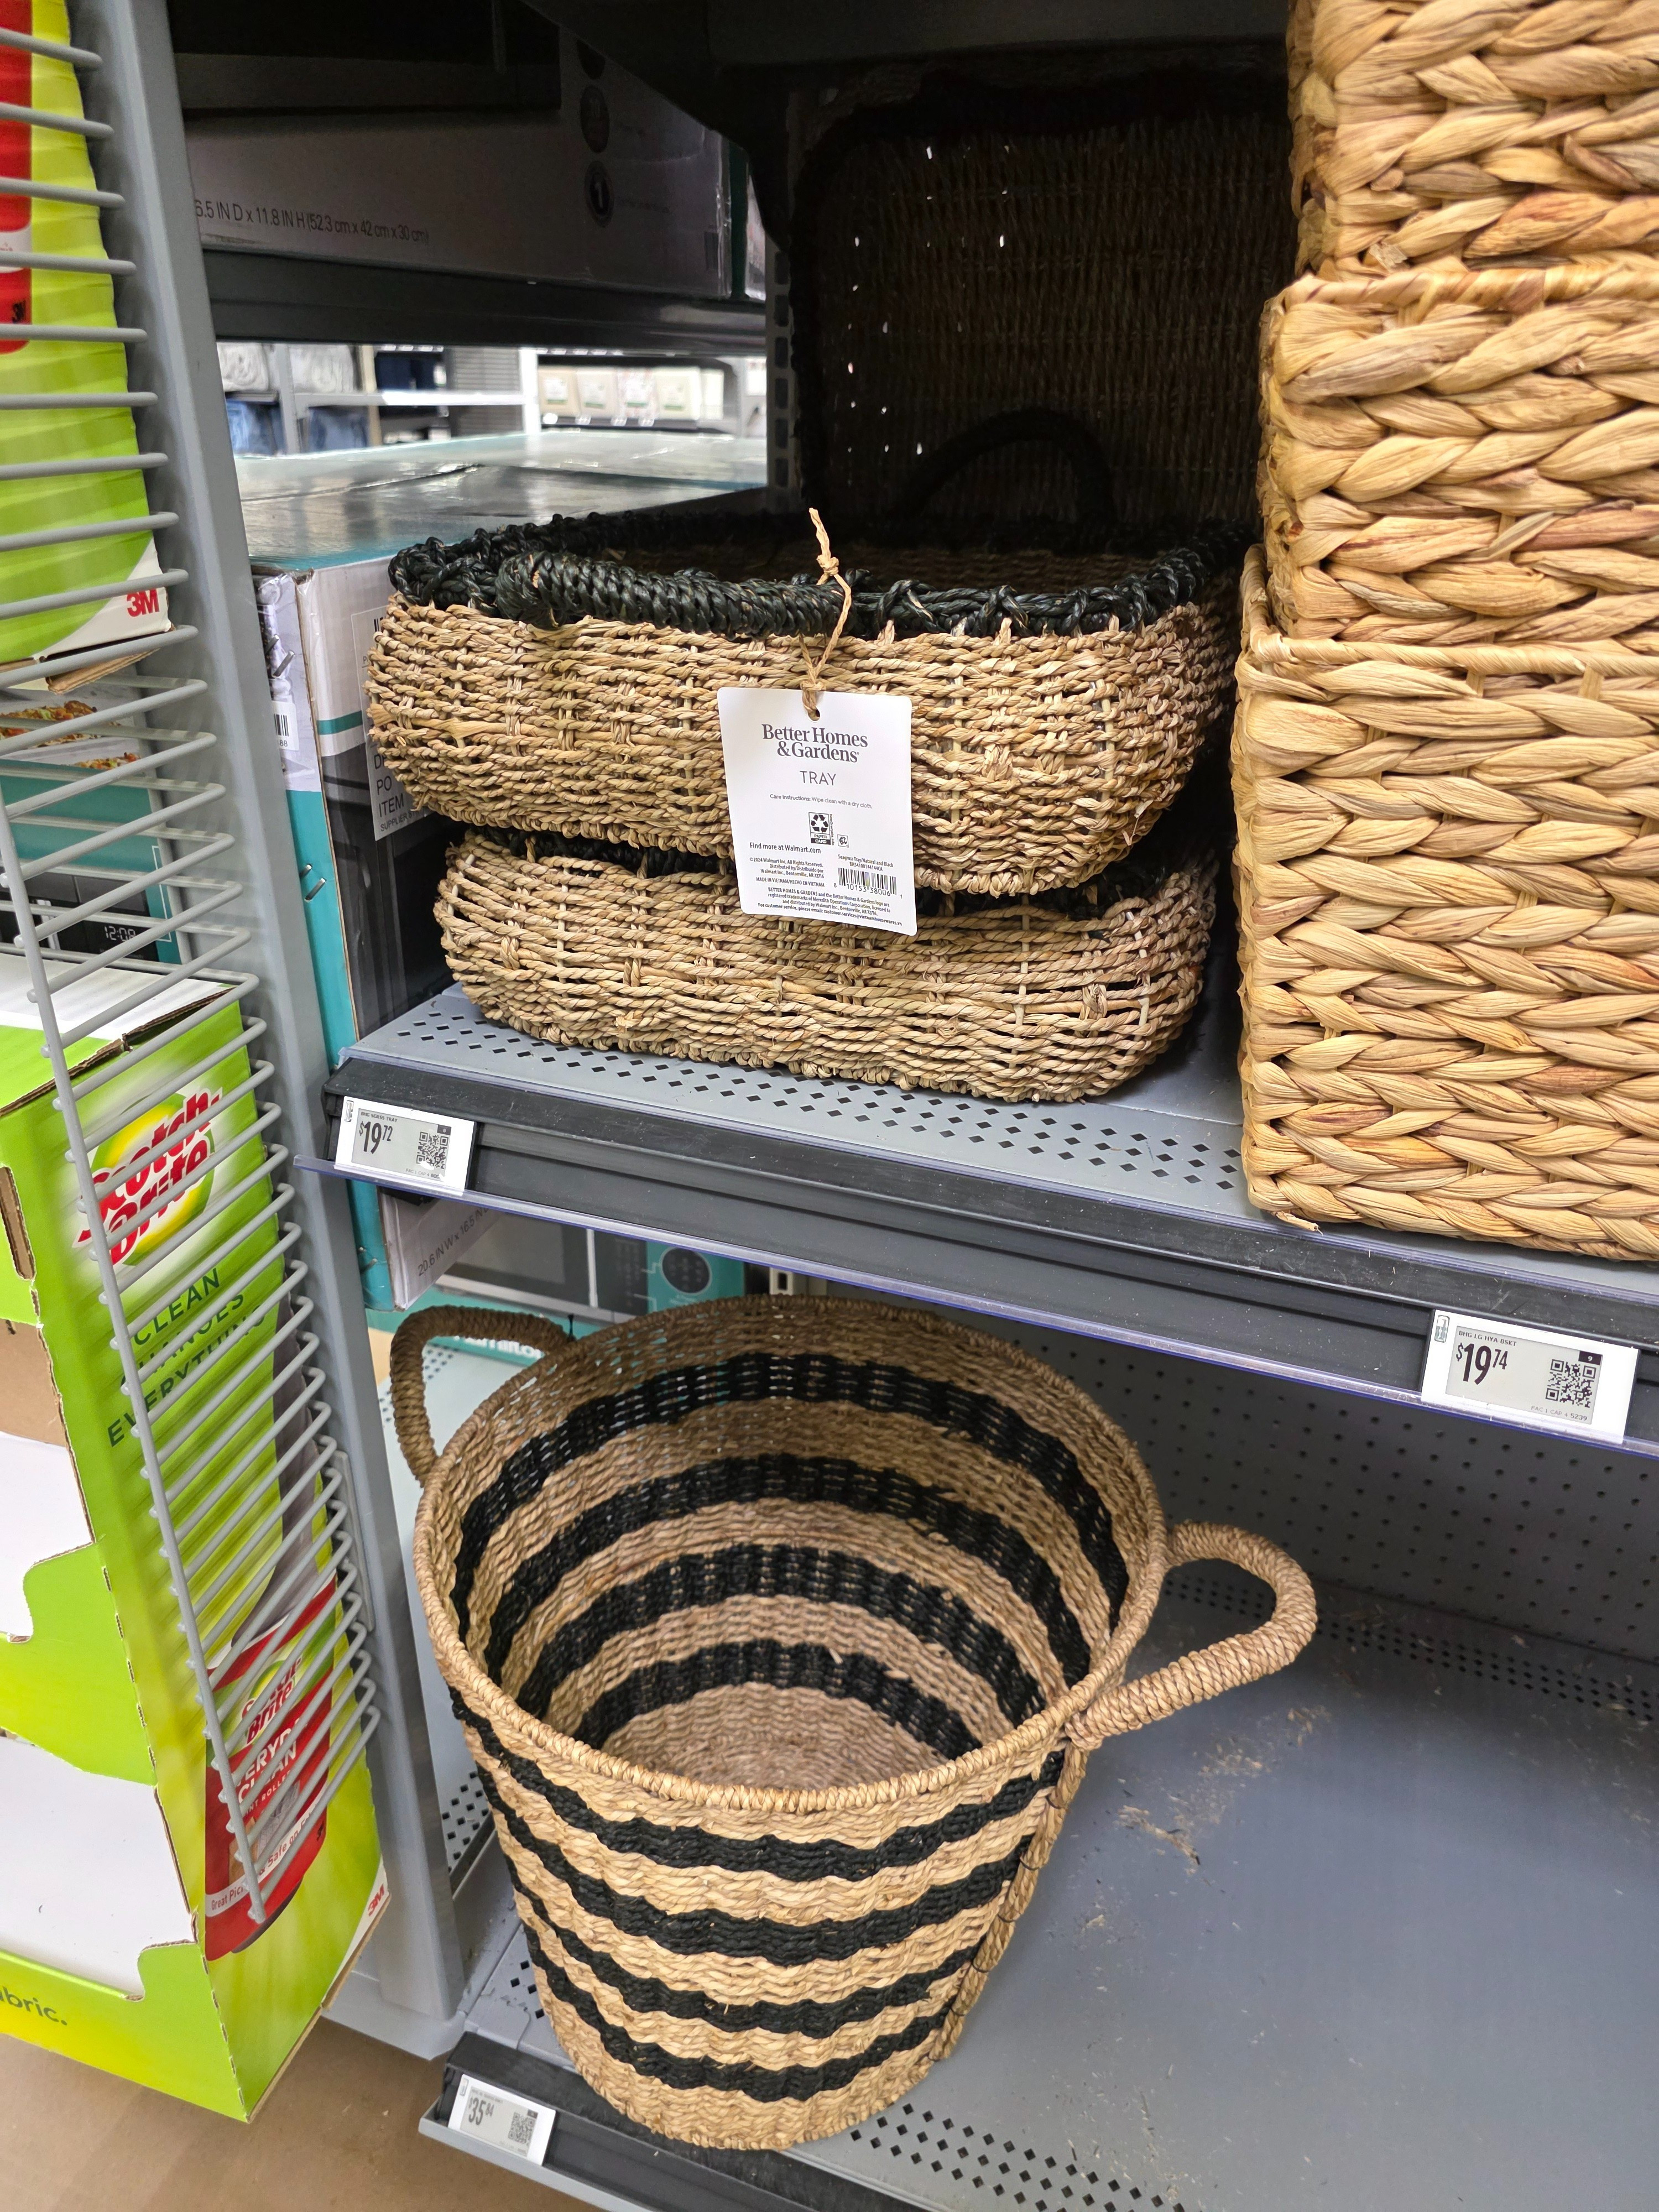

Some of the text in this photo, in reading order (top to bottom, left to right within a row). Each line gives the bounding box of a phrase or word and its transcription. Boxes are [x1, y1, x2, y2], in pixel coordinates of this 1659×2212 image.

[217, 202, 230, 221] IN
[233, 204, 243, 221] D
[257, 207, 279, 226] 11.8
[283, 210, 294, 228] IN
[335, 220, 351, 234] cm
[361, 221, 372, 236] 42
[375, 226, 390, 238] cm
[399, 225, 410, 240] 30
[127, 588, 159, 617] 3M
[761, 724, 868, 747] Better Homes
[377, 776, 392, 795] PO
[800, 770, 836, 786] TRAY
[379, 793, 404, 817] ITEM
[380, 812, 408, 832] SUPPLIER
[785, 844, 821, 853] Walmart.com
[847, 883, 867, 892] 10153
[870, 887, 890, 896] 38006
[105, 926, 135, 942] 12:08
[108, 1139, 208, 1265] Brite
[418, 1254, 435, 1276] 20.6
[436, 1244, 444, 1261] IN
[444, 1235, 453, 1250] W
[455, 1233, 460, 1242] x
[133, 1268, 220, 1345] CLEAN
[1484, 1335, 1498, 1343] HYA
[1500, 1338, 1517, 1347] BSKT
[1570, 1412, 1588, 1421] 5239
[211, 1896, 227, 1911] Great
[268, 1841, 287, 1868] Safe
[289, 1829, 299, 1845] on
[368, 1884, 385, 1917] 3M
